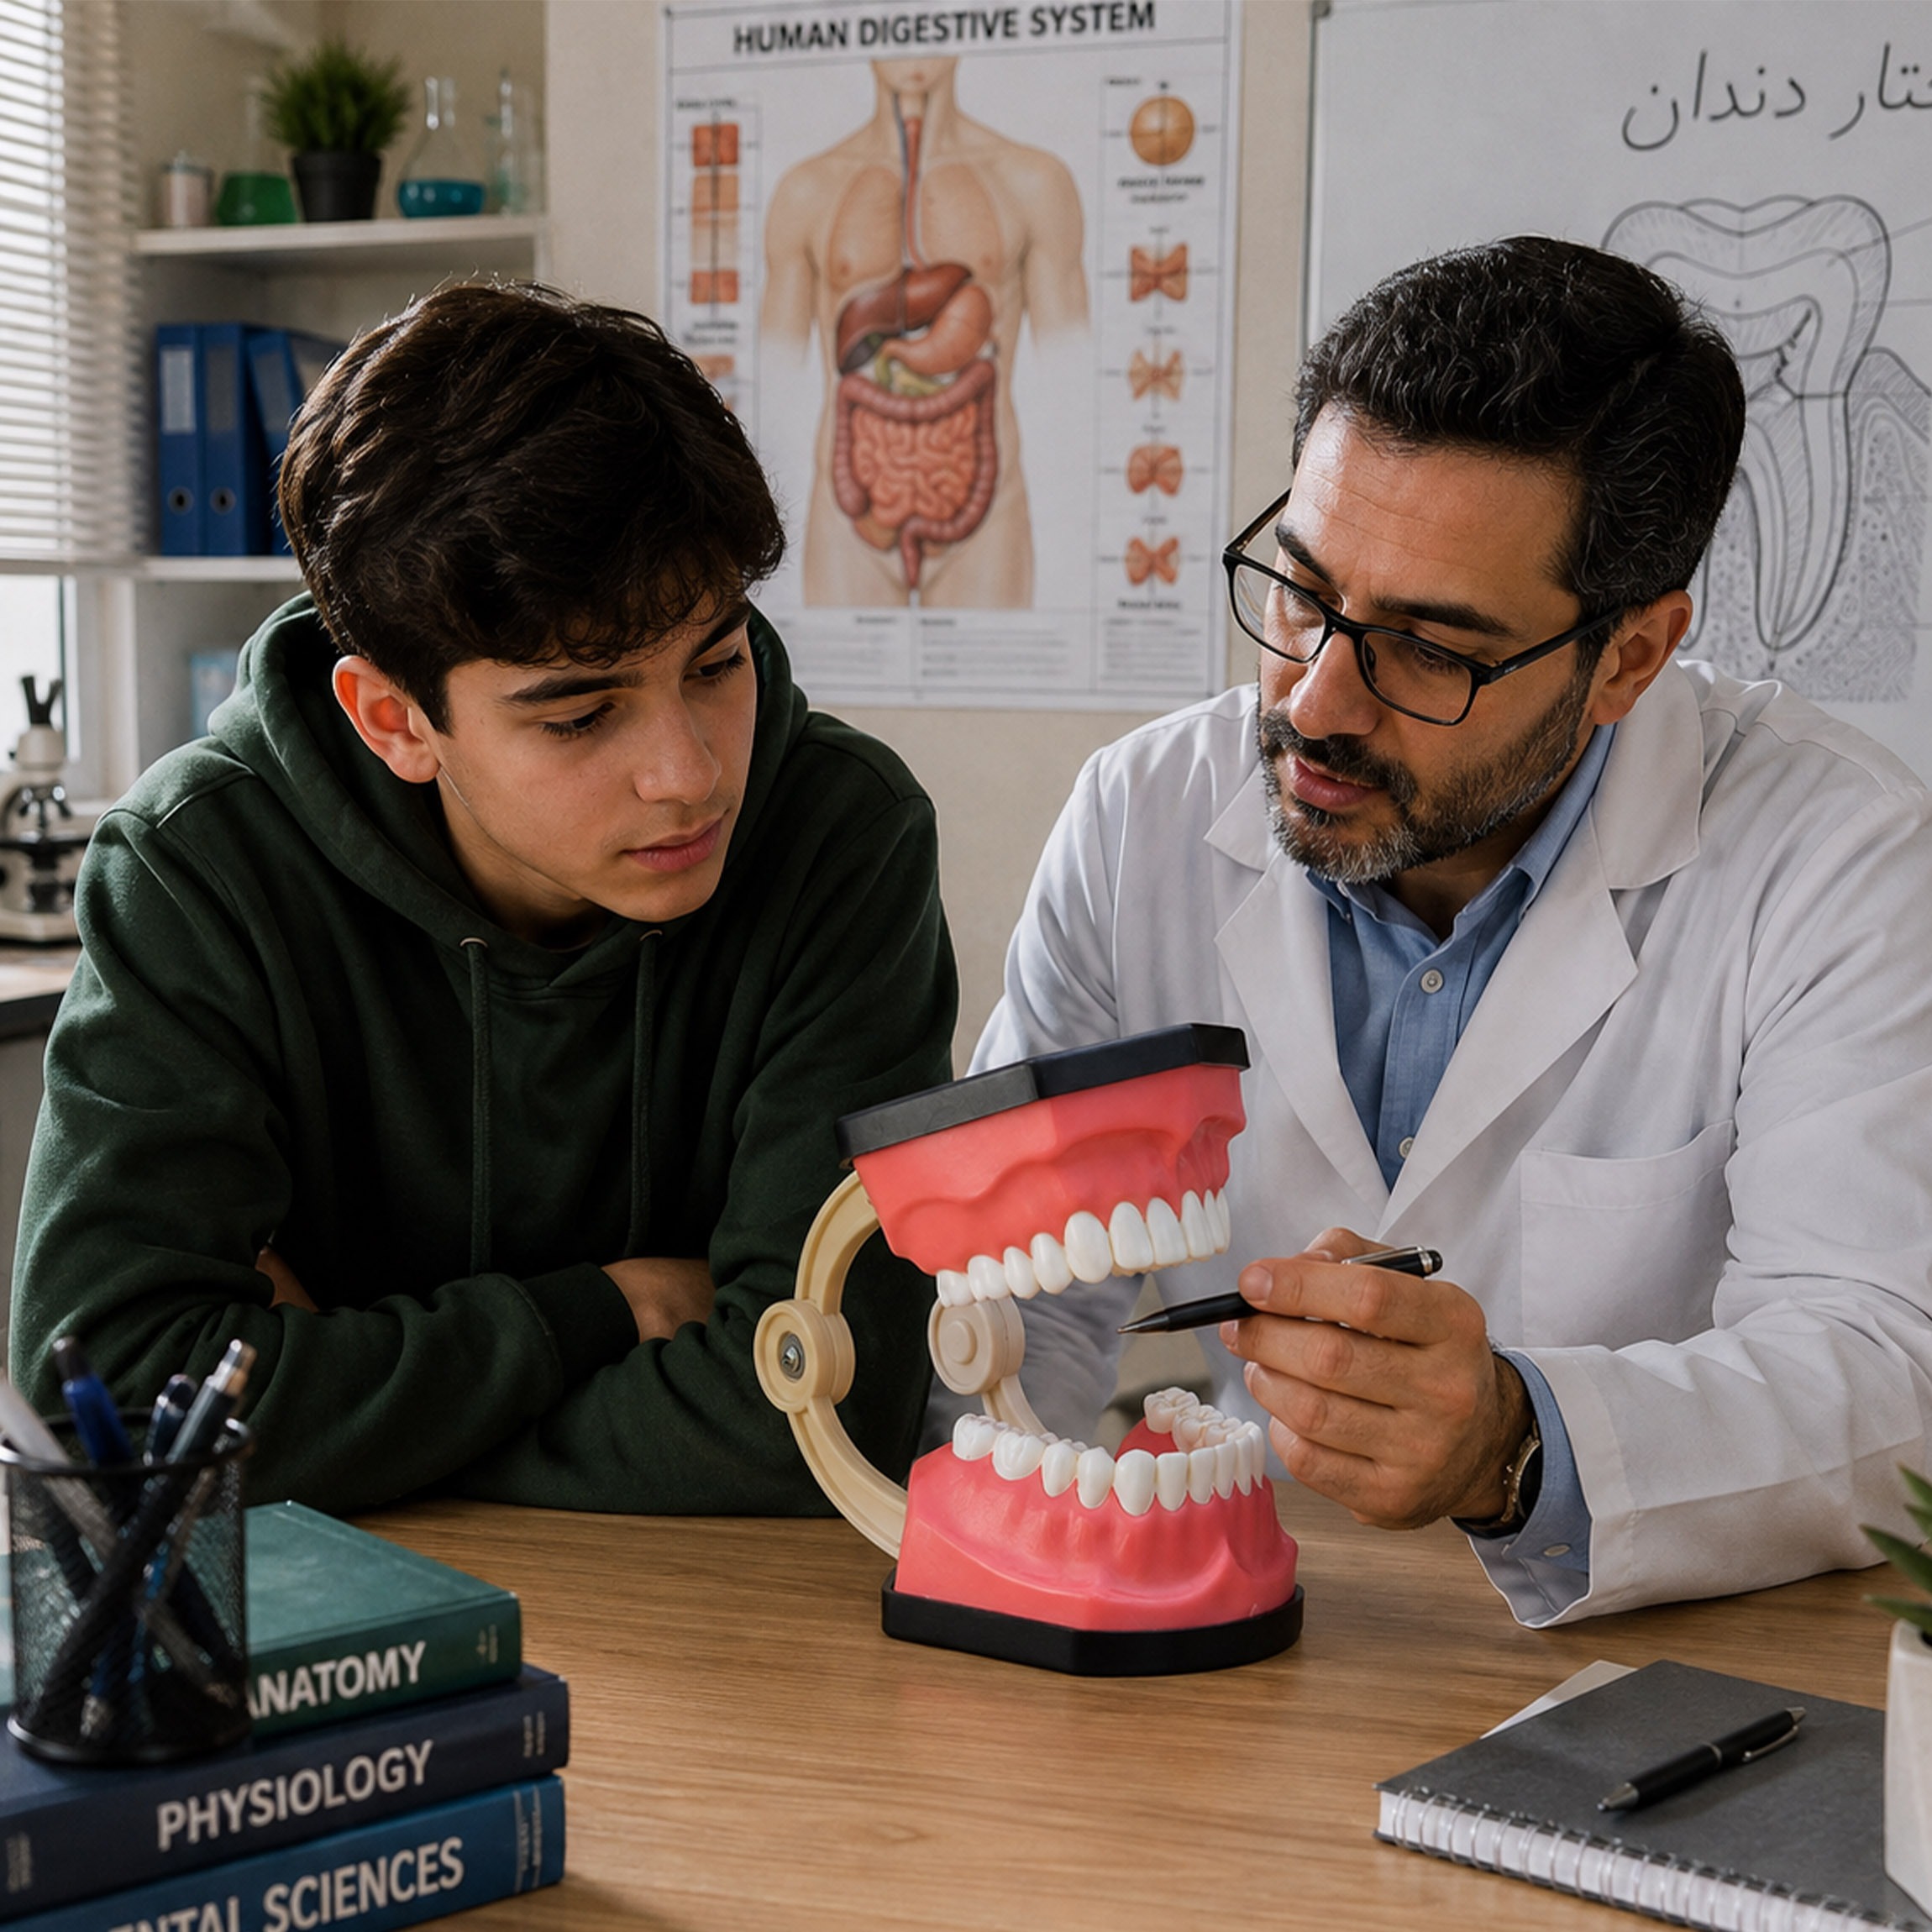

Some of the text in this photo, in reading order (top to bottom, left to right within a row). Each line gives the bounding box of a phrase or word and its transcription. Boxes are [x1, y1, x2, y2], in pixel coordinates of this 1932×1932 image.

[732, 2, 1155, 53] HUMAN DIGESTIVE SYSTEM
[1621, 41, 1932, 151] تار دندان
[157, 1739, 433, 1851] PHYSIOLOGY
[263, 1836, 465, 1932] SCIENCES
